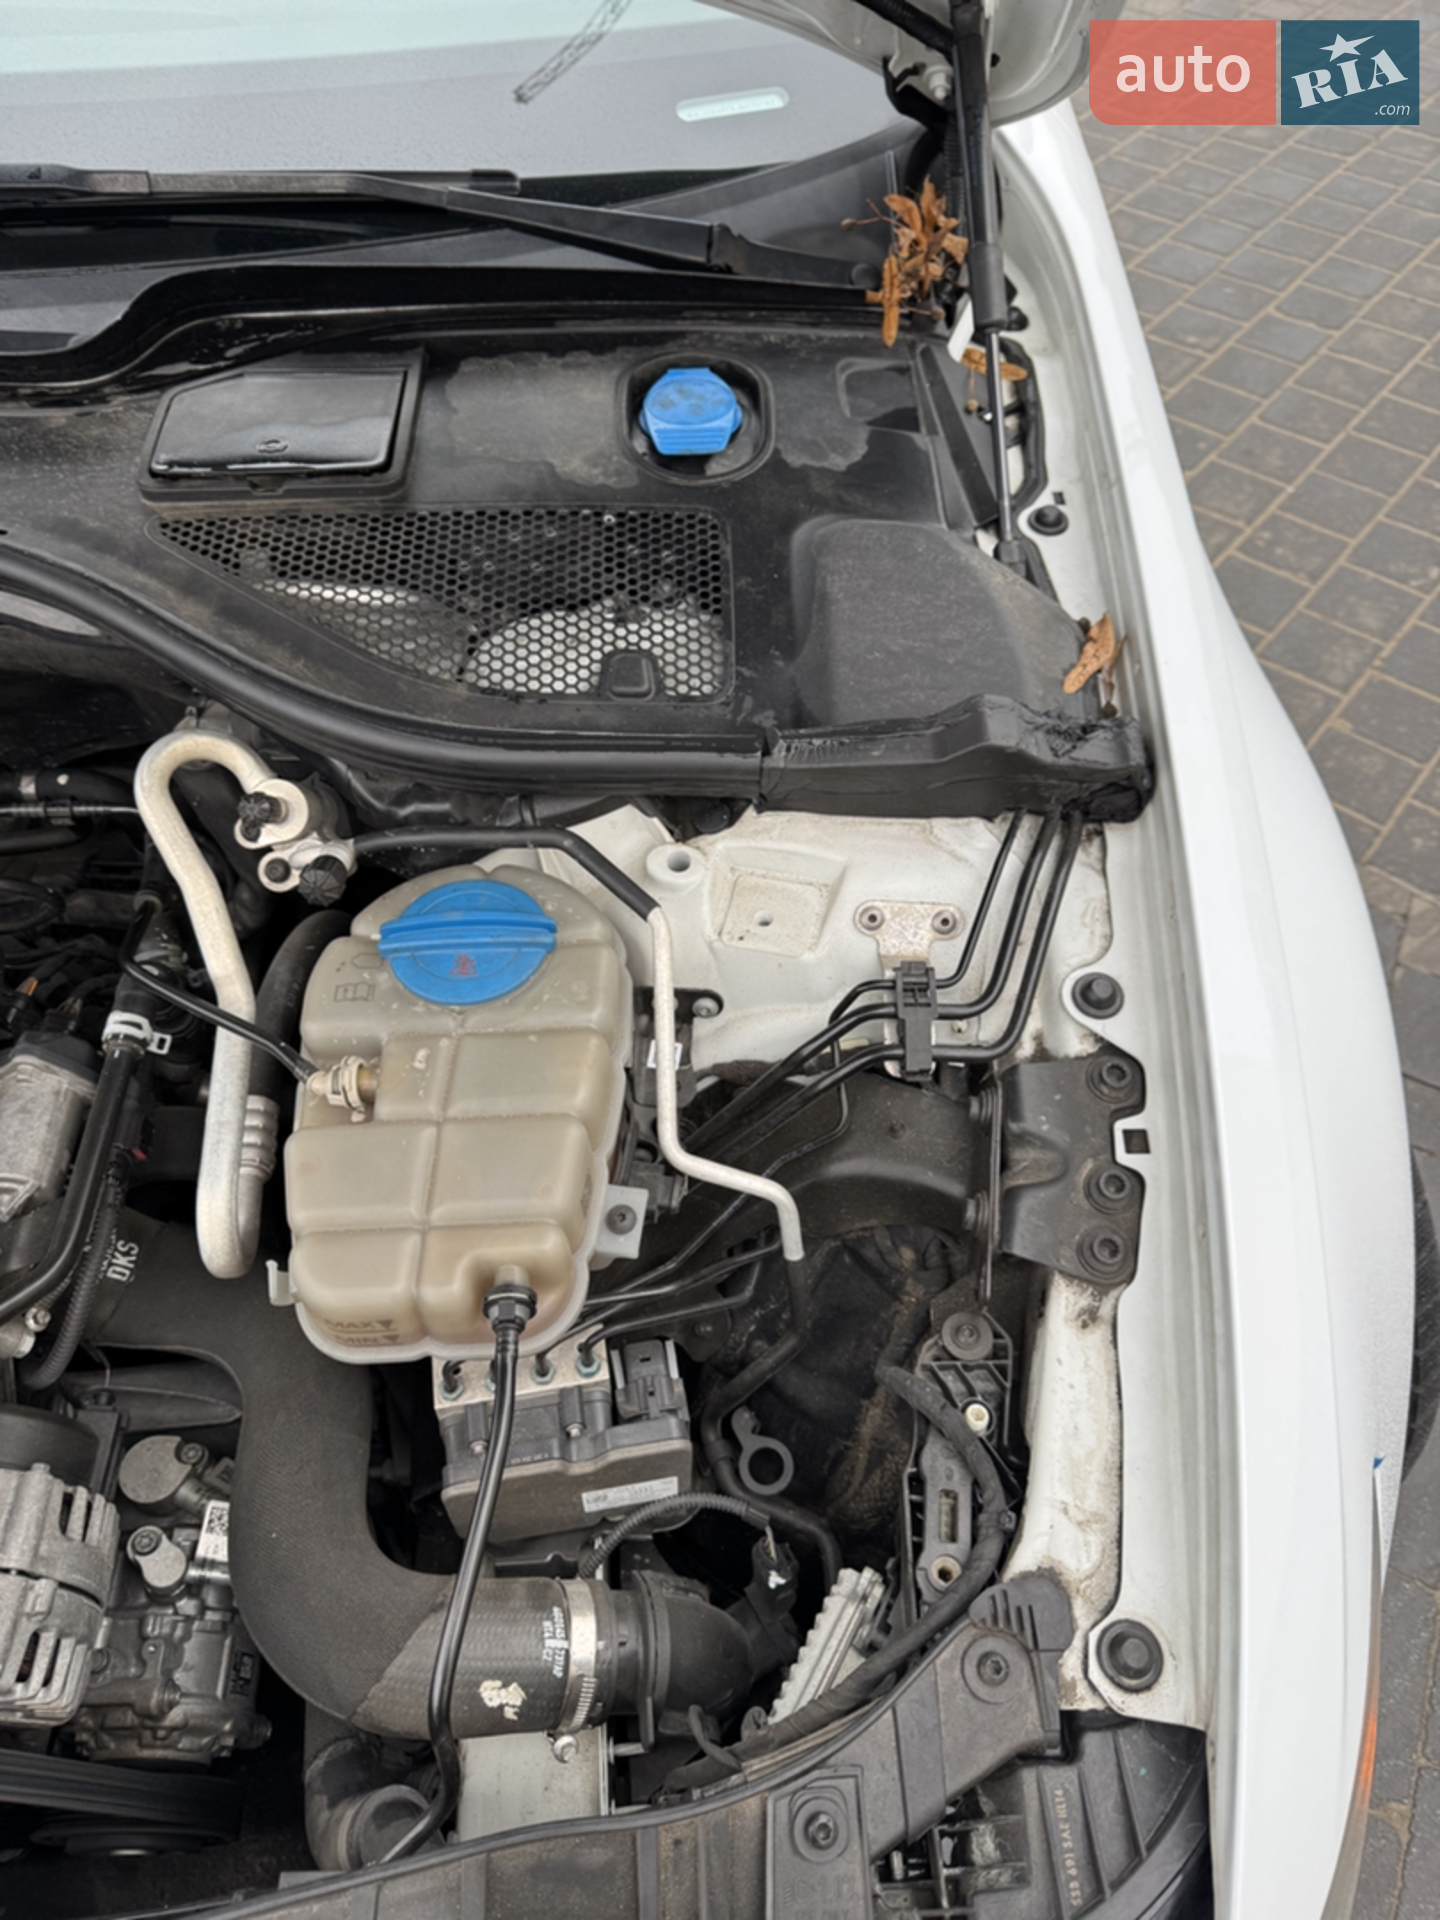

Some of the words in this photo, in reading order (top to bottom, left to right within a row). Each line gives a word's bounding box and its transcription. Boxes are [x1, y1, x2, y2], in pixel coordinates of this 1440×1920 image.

[106, 1240, 140, 1282] DKS
[324, 1318, 376, 1331] MAX
[335, 1333, 378, 1344] MIN
